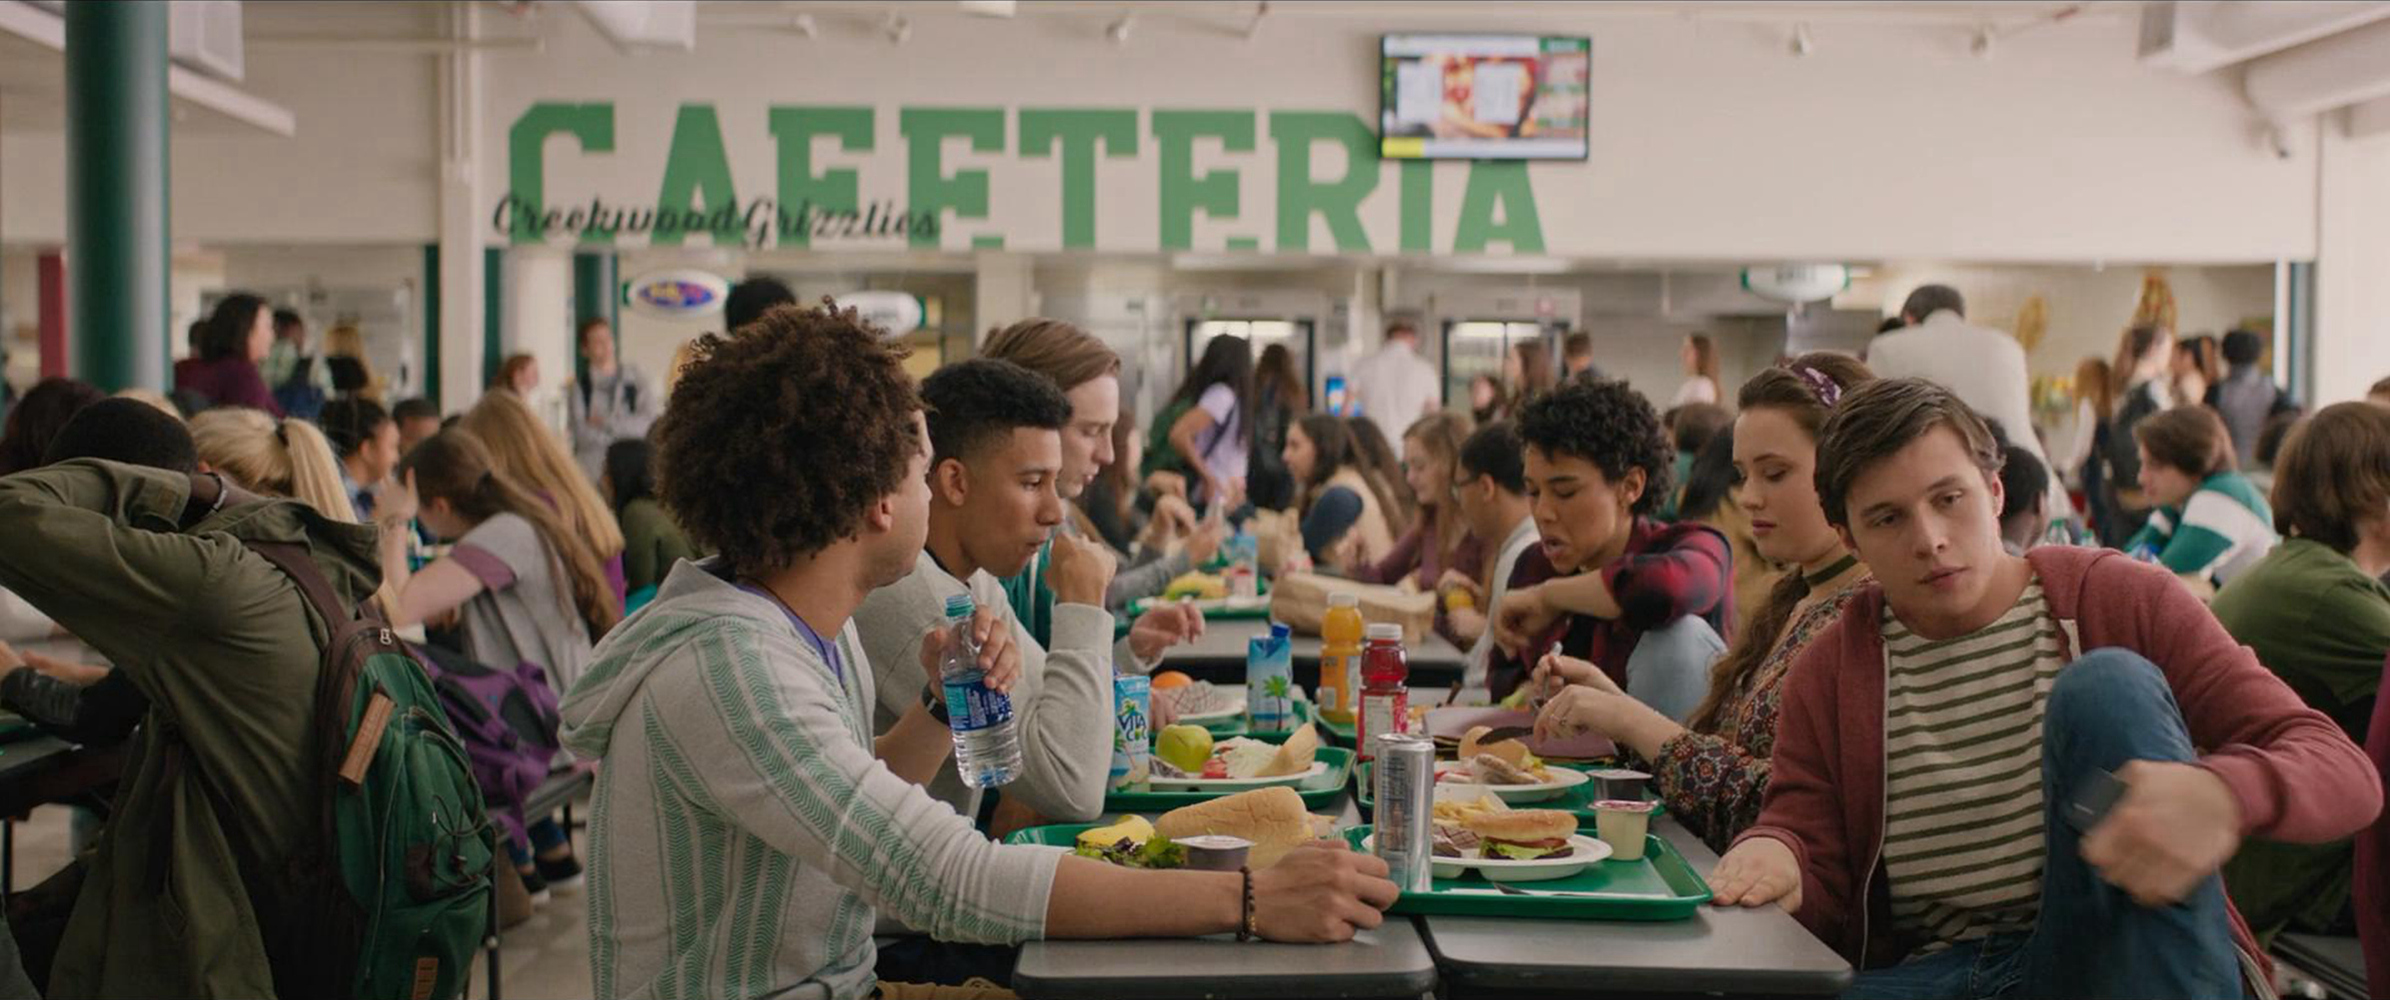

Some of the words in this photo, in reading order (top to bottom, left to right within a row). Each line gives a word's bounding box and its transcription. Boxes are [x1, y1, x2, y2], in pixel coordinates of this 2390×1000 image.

[510, 102, 1547, 252] CAFETERIA
[493, 194, 736, 238] Creekwood
[741, 195, 936, 249] Grizzlies
[1117, 714, 1146, 731] VITA
